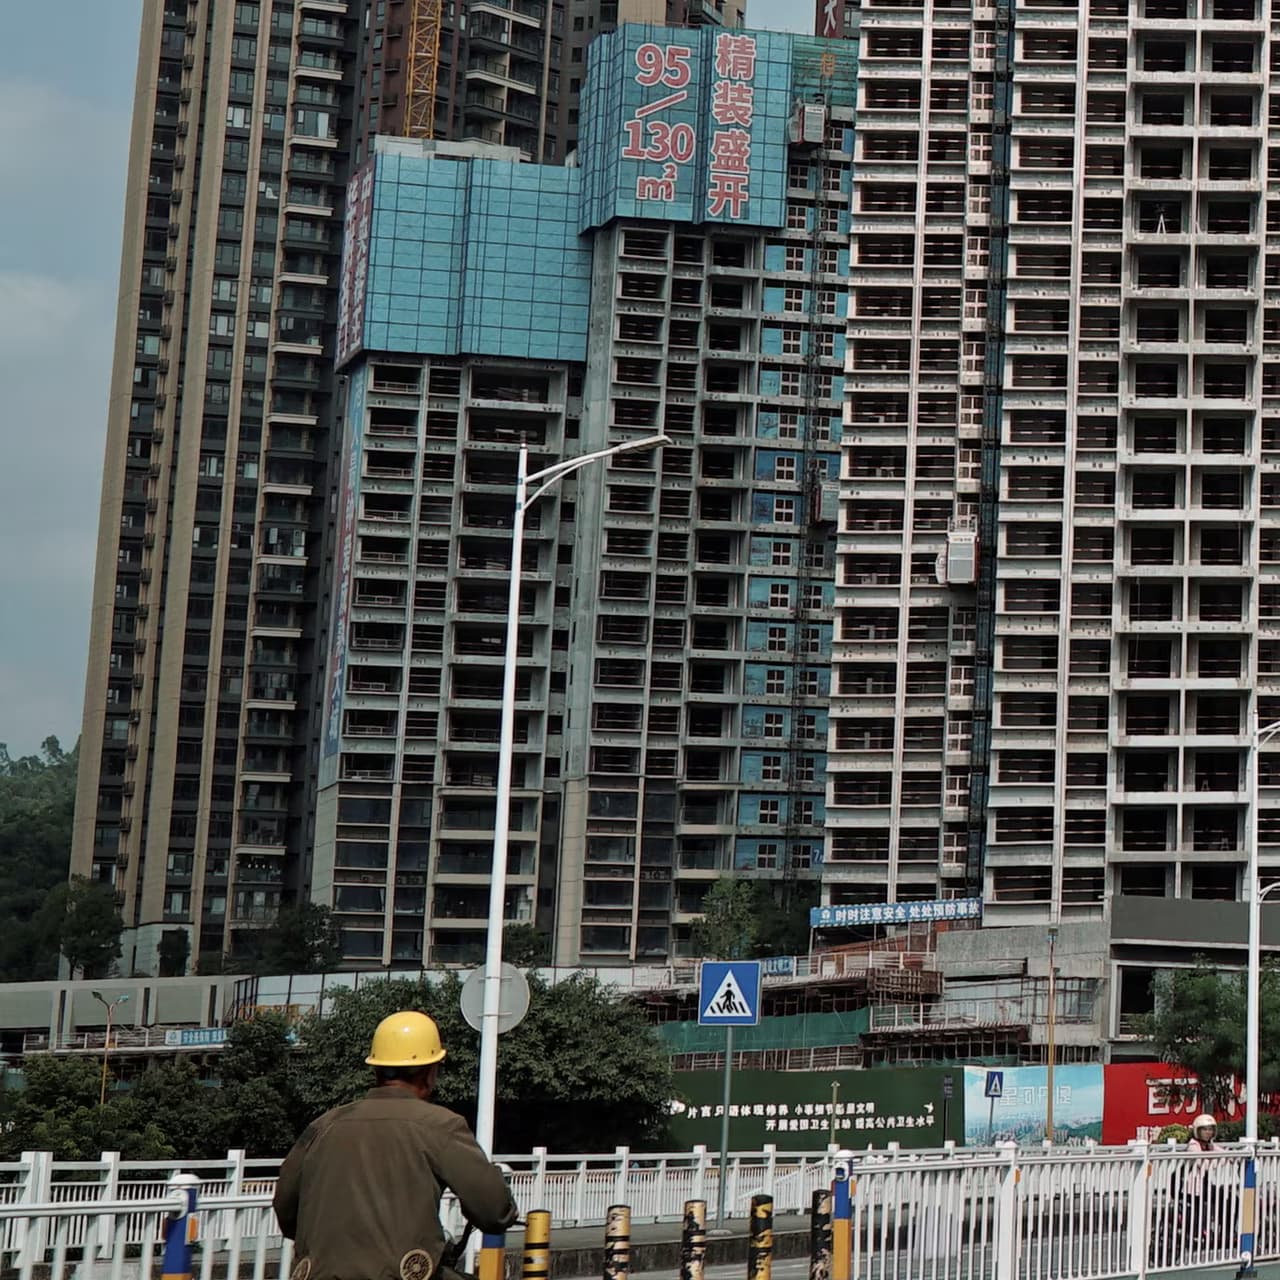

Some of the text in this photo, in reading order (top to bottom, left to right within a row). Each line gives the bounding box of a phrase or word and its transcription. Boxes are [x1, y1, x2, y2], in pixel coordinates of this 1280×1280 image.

[635, 43, 692, 88] 95
[622, 119, 696, 163] 130
[708, 33, 757, 218] 精装盛开
[835, 901, 980, 922] 时时注意安全 处处预防事故
